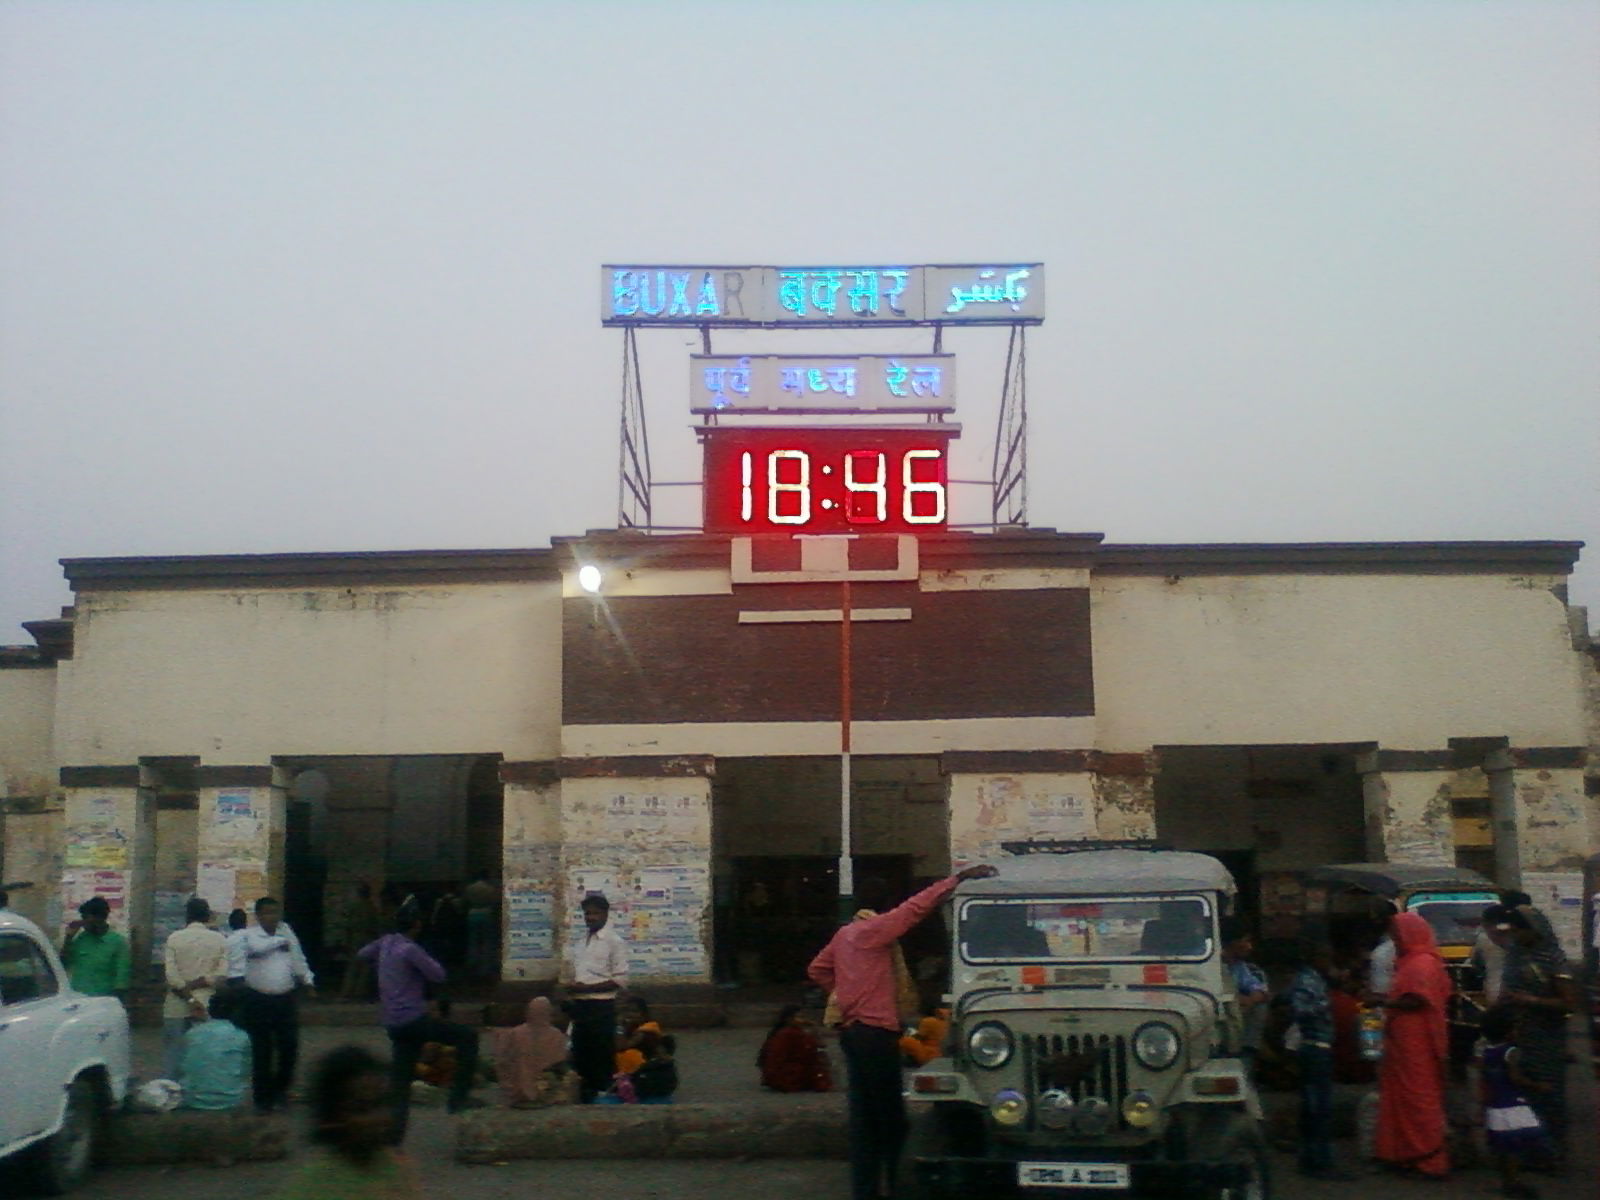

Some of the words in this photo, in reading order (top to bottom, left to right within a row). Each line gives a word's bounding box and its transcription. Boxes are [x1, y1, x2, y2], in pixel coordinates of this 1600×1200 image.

[613, 269, 744, 316] BUXAR
[703, 357, 752, 409] पूर्व
[780, 368, 857, 398] मध्य
[886, 359, 938, 397] रेल
[741, 450, 946, 526] 18:46
